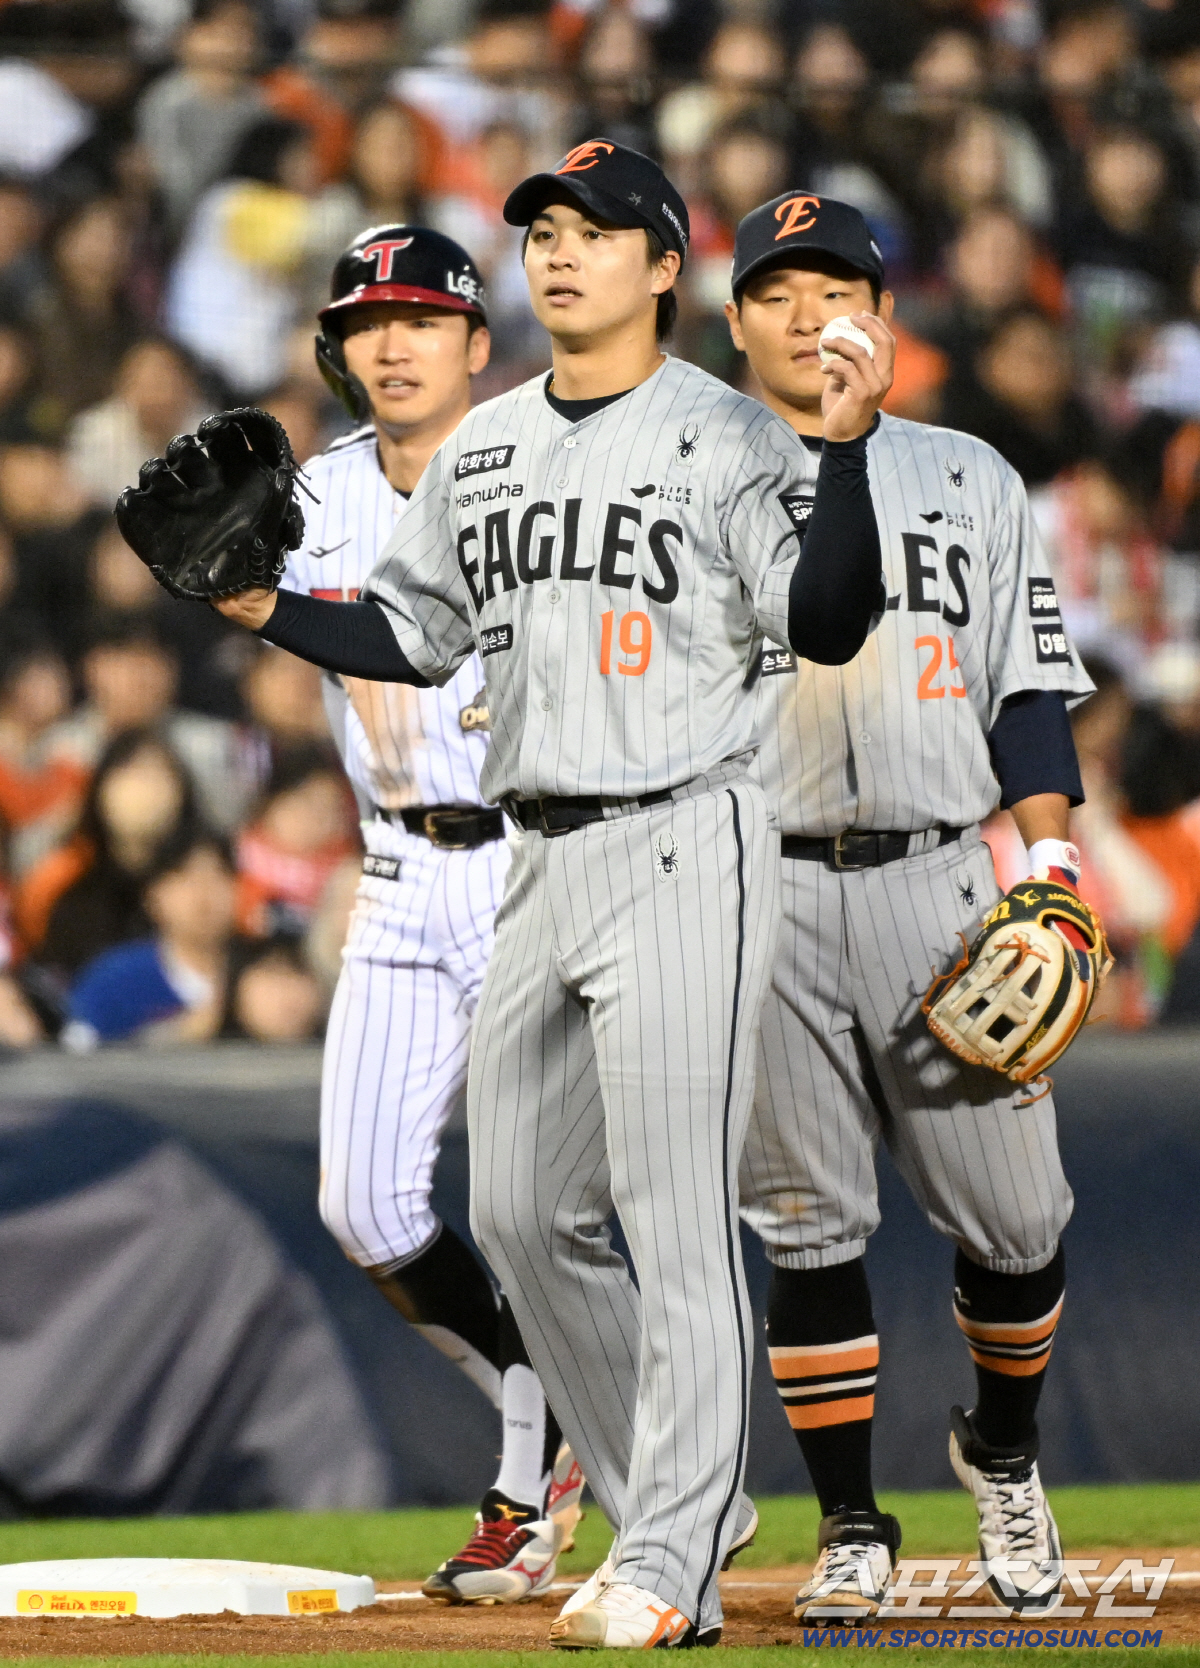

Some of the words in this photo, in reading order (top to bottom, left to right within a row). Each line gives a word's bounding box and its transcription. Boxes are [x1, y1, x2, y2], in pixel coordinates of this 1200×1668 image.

[361, 236, 414, 282] T
[458, 448, 508, 474] 한화생명
[658, 492, 691, 505] PLUS
[659, 485, 693, 496] LIFE
[946, 511, 974, 524] LIFE
[947, 518, 974, 532] PLUS
[457, 498, 684, 617] EAGLES
[600, 610, 653, 677] 19
[914, 634, 967, 700] 25
[51, 1601, 86, 1611] HELIX
[90, 1600, 126, 1612] 엔진오일
